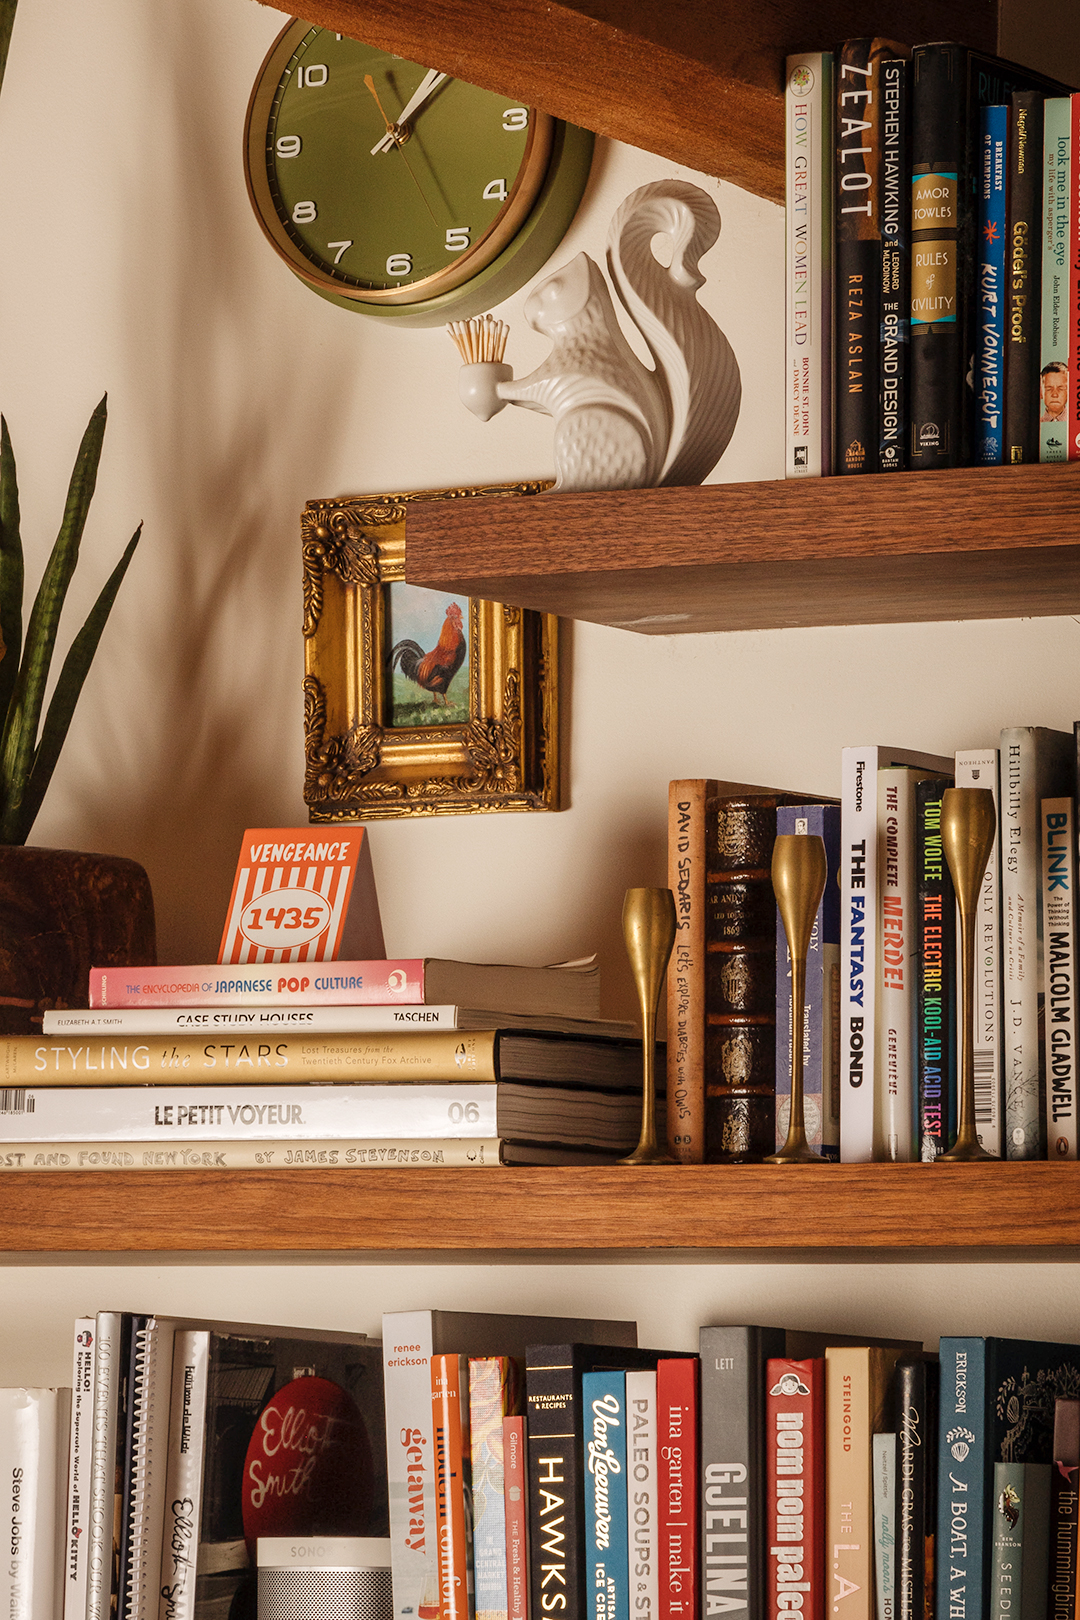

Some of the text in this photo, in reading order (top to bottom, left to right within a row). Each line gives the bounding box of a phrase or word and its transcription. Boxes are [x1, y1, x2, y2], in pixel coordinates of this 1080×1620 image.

[298, 64, 328, 88] 10
[502, 107, 528, 131] 3
[276, 136, 301, 158] 9
[841, 62, 872, 217] ZEALOT
[884, 68, 900, 234] STEPHEN HAWKING
[983, 134, 992, 200] OF CHAMPIONS
[995, 141, 1003, 191] BREAKFAST
[1047, 153, 1054, 167] my
[1048, 169, 1056, 183] life
[483, 178, 508, 202] 4
[916, 188, 949, 200] AMOR
[1053, 136, 1070, 266] look me in the eye
[292, 200, 318, 224] 8
[794, 104, 808, 346] HOW GREAT WOMEN LEAD
[914, 206, 951, 220] TOWLES
[327, 240, 354, 264] 7
[444, 227, 471, 251] 5
[884, 239, 899, 247] and
[386, 253, 413, 276] 6
[882, 250, 891, 294] MLODINOW
[891, 252, 900, 290] LEONARD
[915, 252, 949, 267] RULES
[925, 274, 936, 290] of
[981, 263, 998, 318] KURT
[883, 302, 899, 311] THE
[911, 296, 954, 312] CIVILITY
[1052, 275, 1061, 347] John Elder Robison
[848, 275, 863, 393] REZA ASLAN
[883, 314, 898, 440] GRAND DESIGN
[978, 323, 1000, 429] VONNEGUT
[802, 357, 810, 436] BONNIE JOHN
[855, 761, 865, 813] Firestone
[1007, 744, 1022, 875] Hillbilly Elegy
[250, 842, 351, 863] VENGEANCE
[886, 786, 899, 887] THE COMPLETE
[924, 799, 942, 881] TOM WOLFE
[1046, 812, 1069, 892] BLINK
[676, 801, 692, 930] DAVID SEDARIS
[983, 871, 994, 914] ONLY
[247, 907, 324, 930] 1435
[1016, 893, 1026, 981] A Memoir Family
[884, 896, 904, 991] MERDE!
[849, 839, 866, 1089] THE FANTASY BOND
[983, 923, 994, 1043] REVOLUTIONS
[126, 976, 363, 994] THE ENCYCLOPEDIA OF JAPANESE POP CULTURE
[57, 1018, 90, 1026] ELIZABETH
[176, 1012, 314, 1028] CASE STUDY HOUSES
[393, 1012, 440, 1022] TASCHEN
[923, 894, 942, 1138] THE ELECTRIC KOOL-AID ACID TEST
[1049, 932, 1072, 1123] MALCOLM GLADWELL
[34, 1044, 289, 1071] STYLING the STARS
[301, 1045, 394, 1054] Lost Treasures the
[301, 1056, 432, 1065] Twentieth Fox Archive
[154, 1104, 224, 1126] LE PETIT
[447, 1102, 480, 1125] 06
[674, 1089, 691, 1120] OWLS
[33, 1148, 445, 1167] AND FOUND BY JAMES STEVENSON
[387, 1356, 428, 1367] erickson
[393, 1344, 421, 1353] renee
[715, 1357, 735, 1370] LETT
[76, 1352, 84, 1392] Exploring
[83, 1352, 92, 1392] HELLO!
[955, 1352, 967, 1414] ERICKSON
[528, 1394, 573, 1403] RESTAURANTS
[842, 1375, 852, 1452] STEINGOLD
[73, 1412, 82, 1454] Supercute
[509, 1432, 518, 1469] Gilmore
[72, 1484, 79, 1493] of
[400, 1427, 428, 1556] getaway
[632, 1399, 651, 1592] PALEO SOUPS &
[776, 1412, 804, 1542] nom nom
[10, 1467, 24, 1556] Steve Jobs
[71, 1495, 81, 1536] HELLO
[661, 1405, 691, 1614] ina garten make it
[840, 1501, 853, 1533] THE
[901, 1487, 914, 1532] GRAS
[1058, 1490, 1078, 1515] the
[704, 1462, 748, 1616] GJELINA
[878, 1514, 895, 1550] molly
[948, 1472, 968, 1581] A BOAT, A
[70, 1539, 79, 1582] KITTY
[440, 1524, 461, 1617] comfort
[512, 1539, 520, 1565] Fresh
[595, 1562, 606, 1588] ICE
[512, 1577, 522, 1614] Healthy
